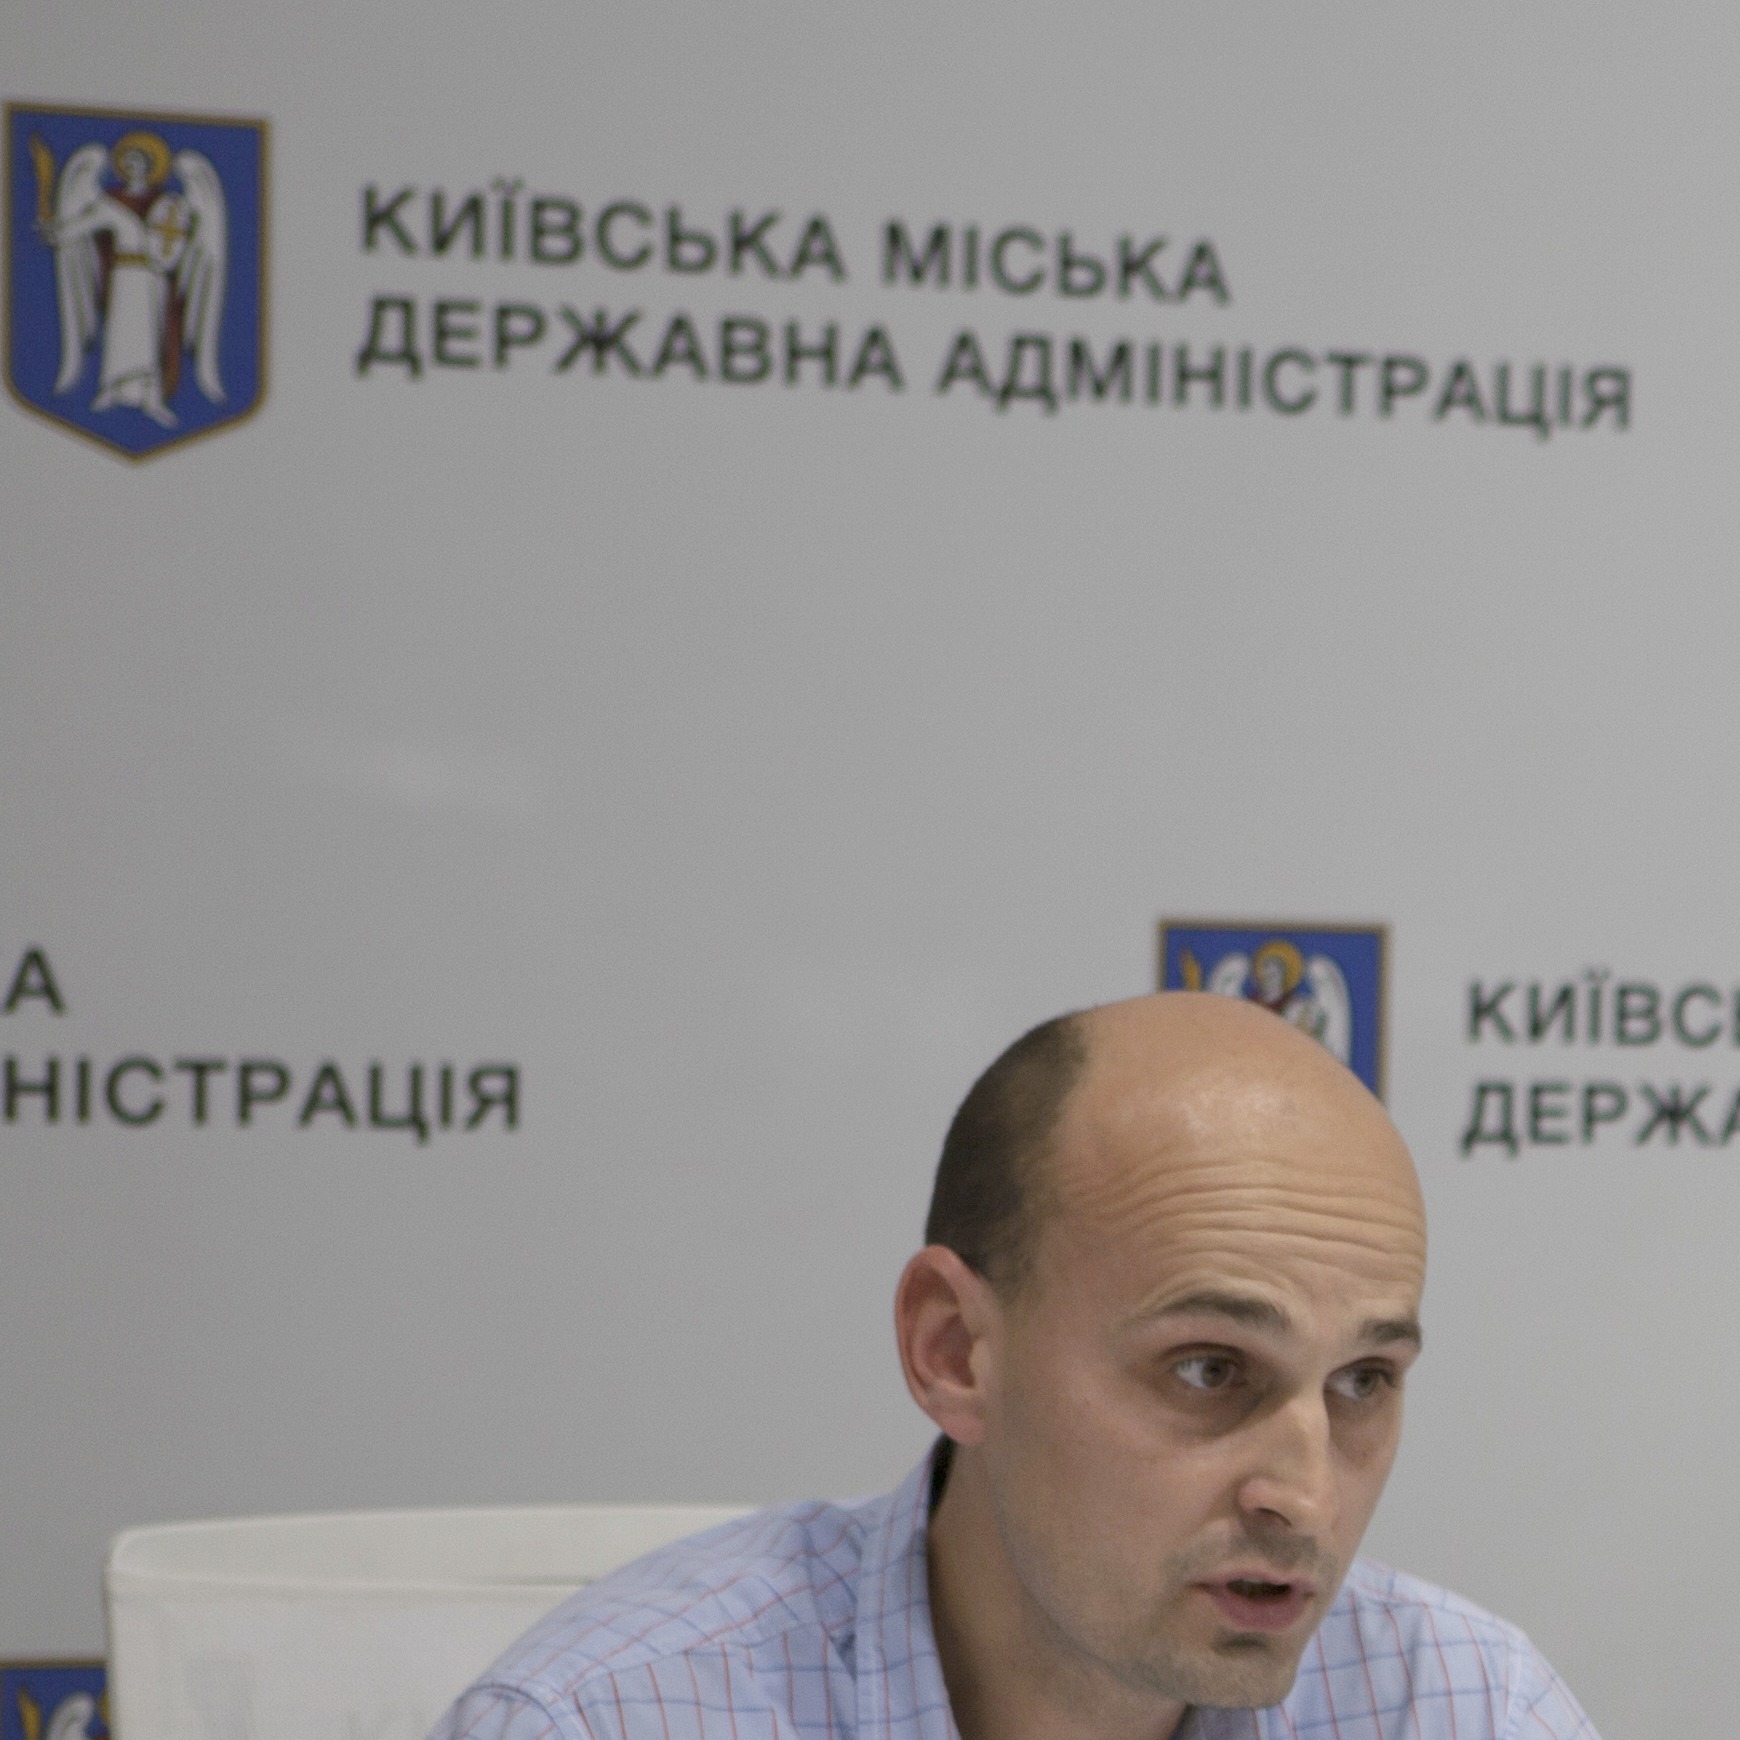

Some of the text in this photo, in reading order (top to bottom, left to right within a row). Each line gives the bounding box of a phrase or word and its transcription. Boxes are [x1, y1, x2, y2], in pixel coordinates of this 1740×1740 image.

[358, 176, 1233, 307] КИЇВСЬКА МІСЬКА
[352, 292, 1634, 441] ДЕРЖАВНА АДМІНІСТРАЦІЯ
